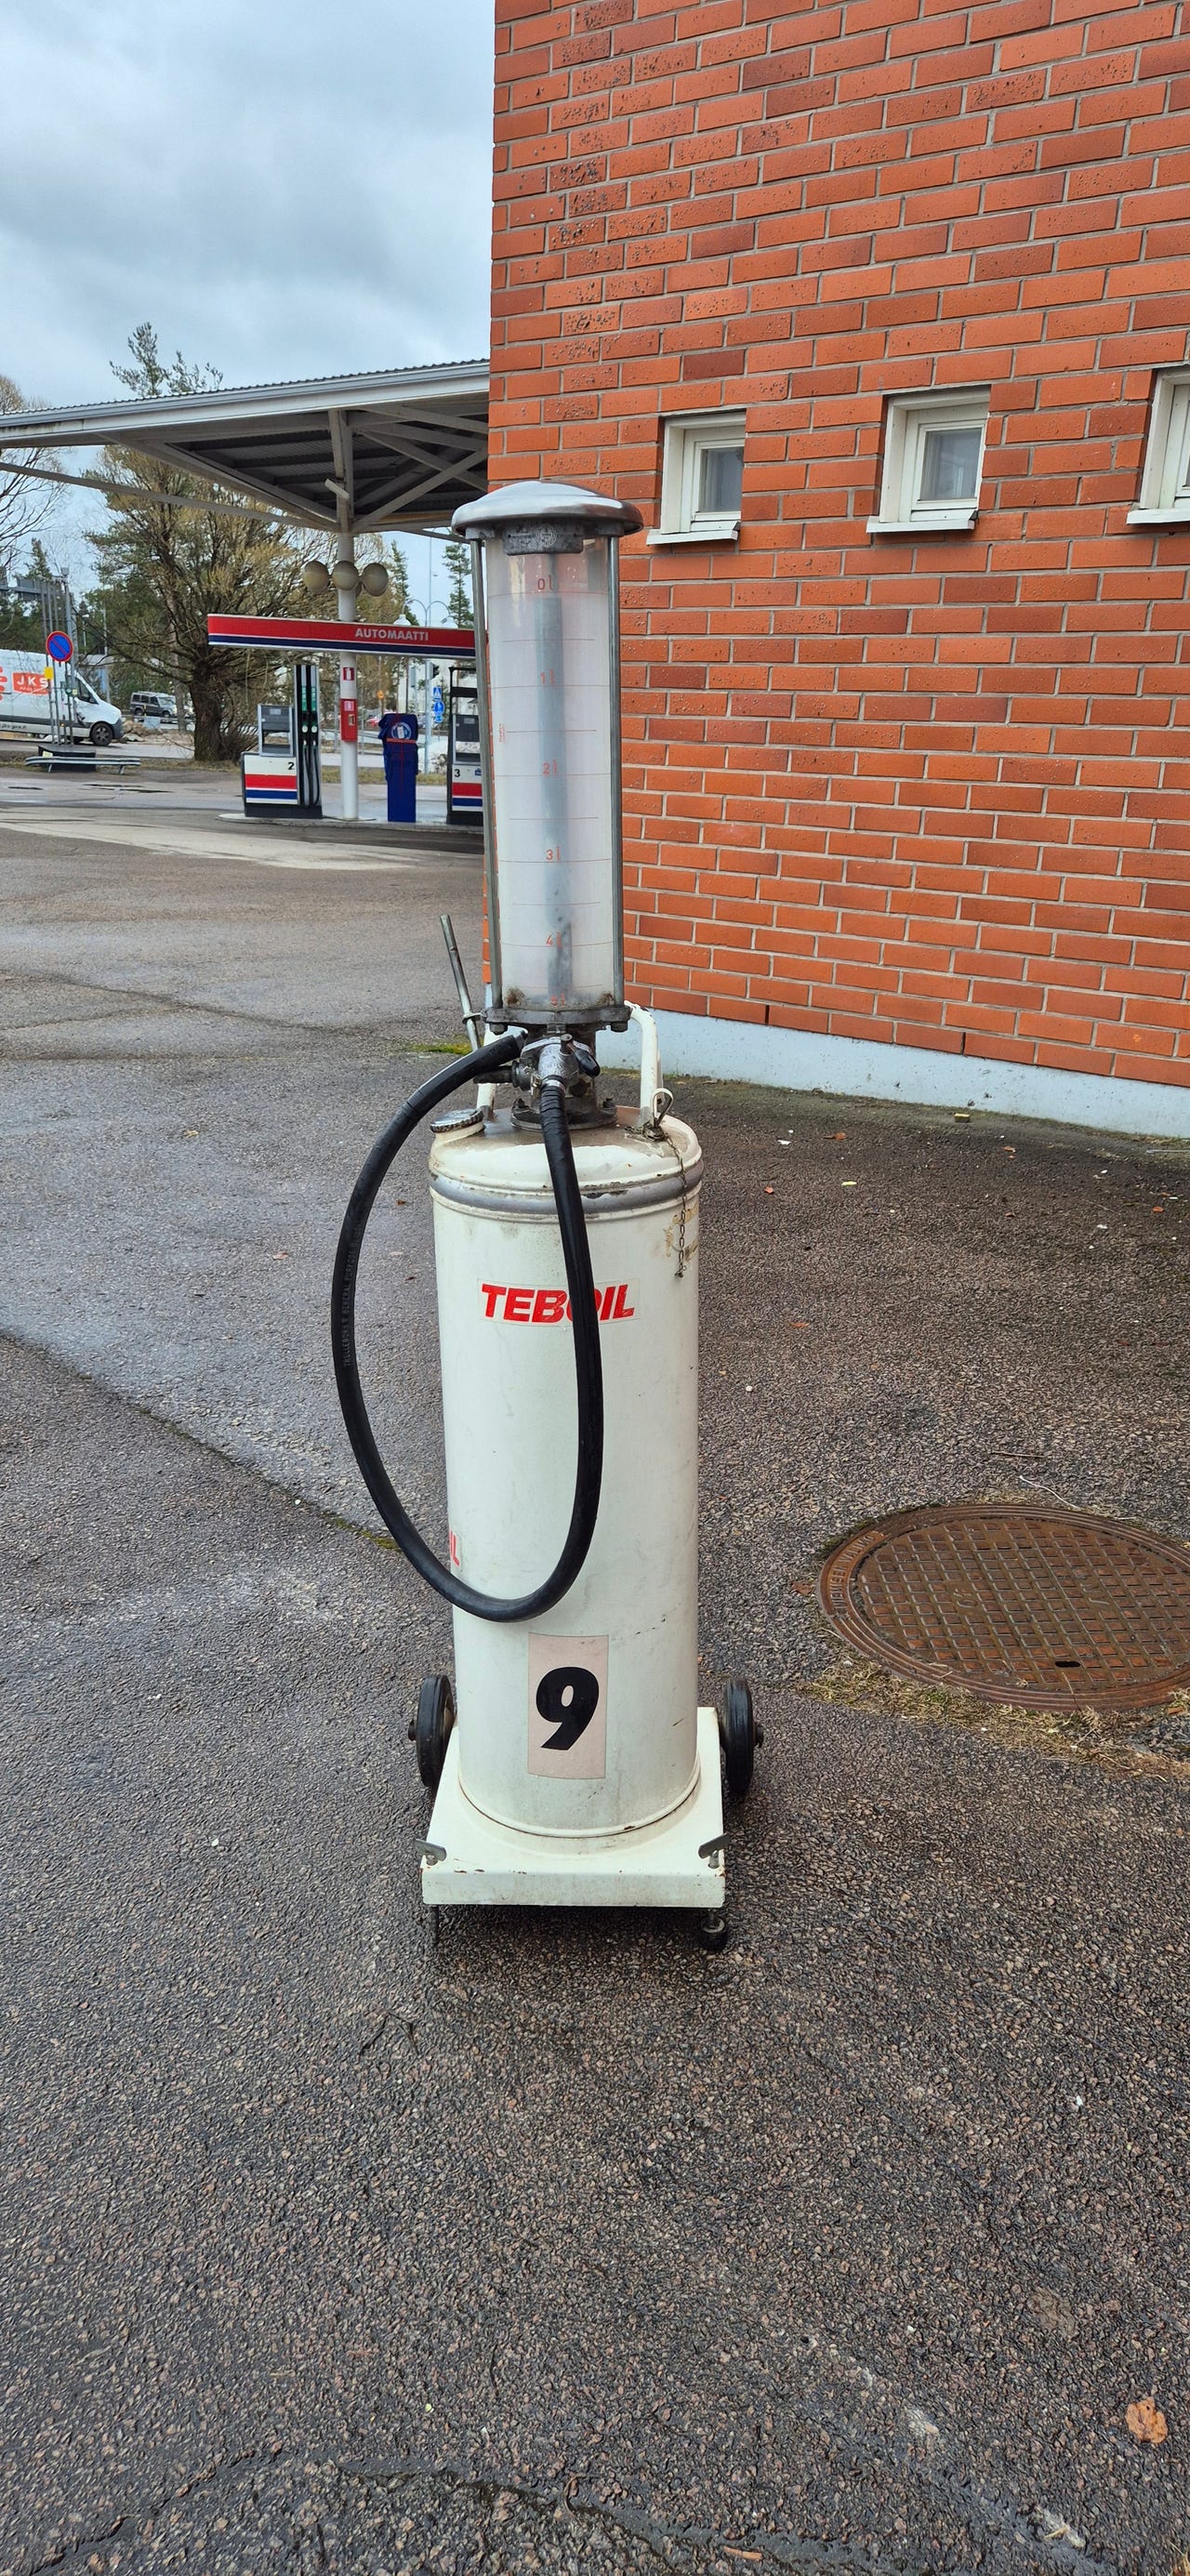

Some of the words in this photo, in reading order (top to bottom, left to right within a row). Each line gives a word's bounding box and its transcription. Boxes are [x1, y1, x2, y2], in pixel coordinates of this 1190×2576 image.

[355, 628, 429, 641] AUTOMAATTI
[17, 675, 49, 689] JKS
[287, 761, 296, 771] 2
[454, 768, 461, 778] 3
[482, 1283, 635, 1324] TEBIL
[536, 1667, 600, 1750] 9
